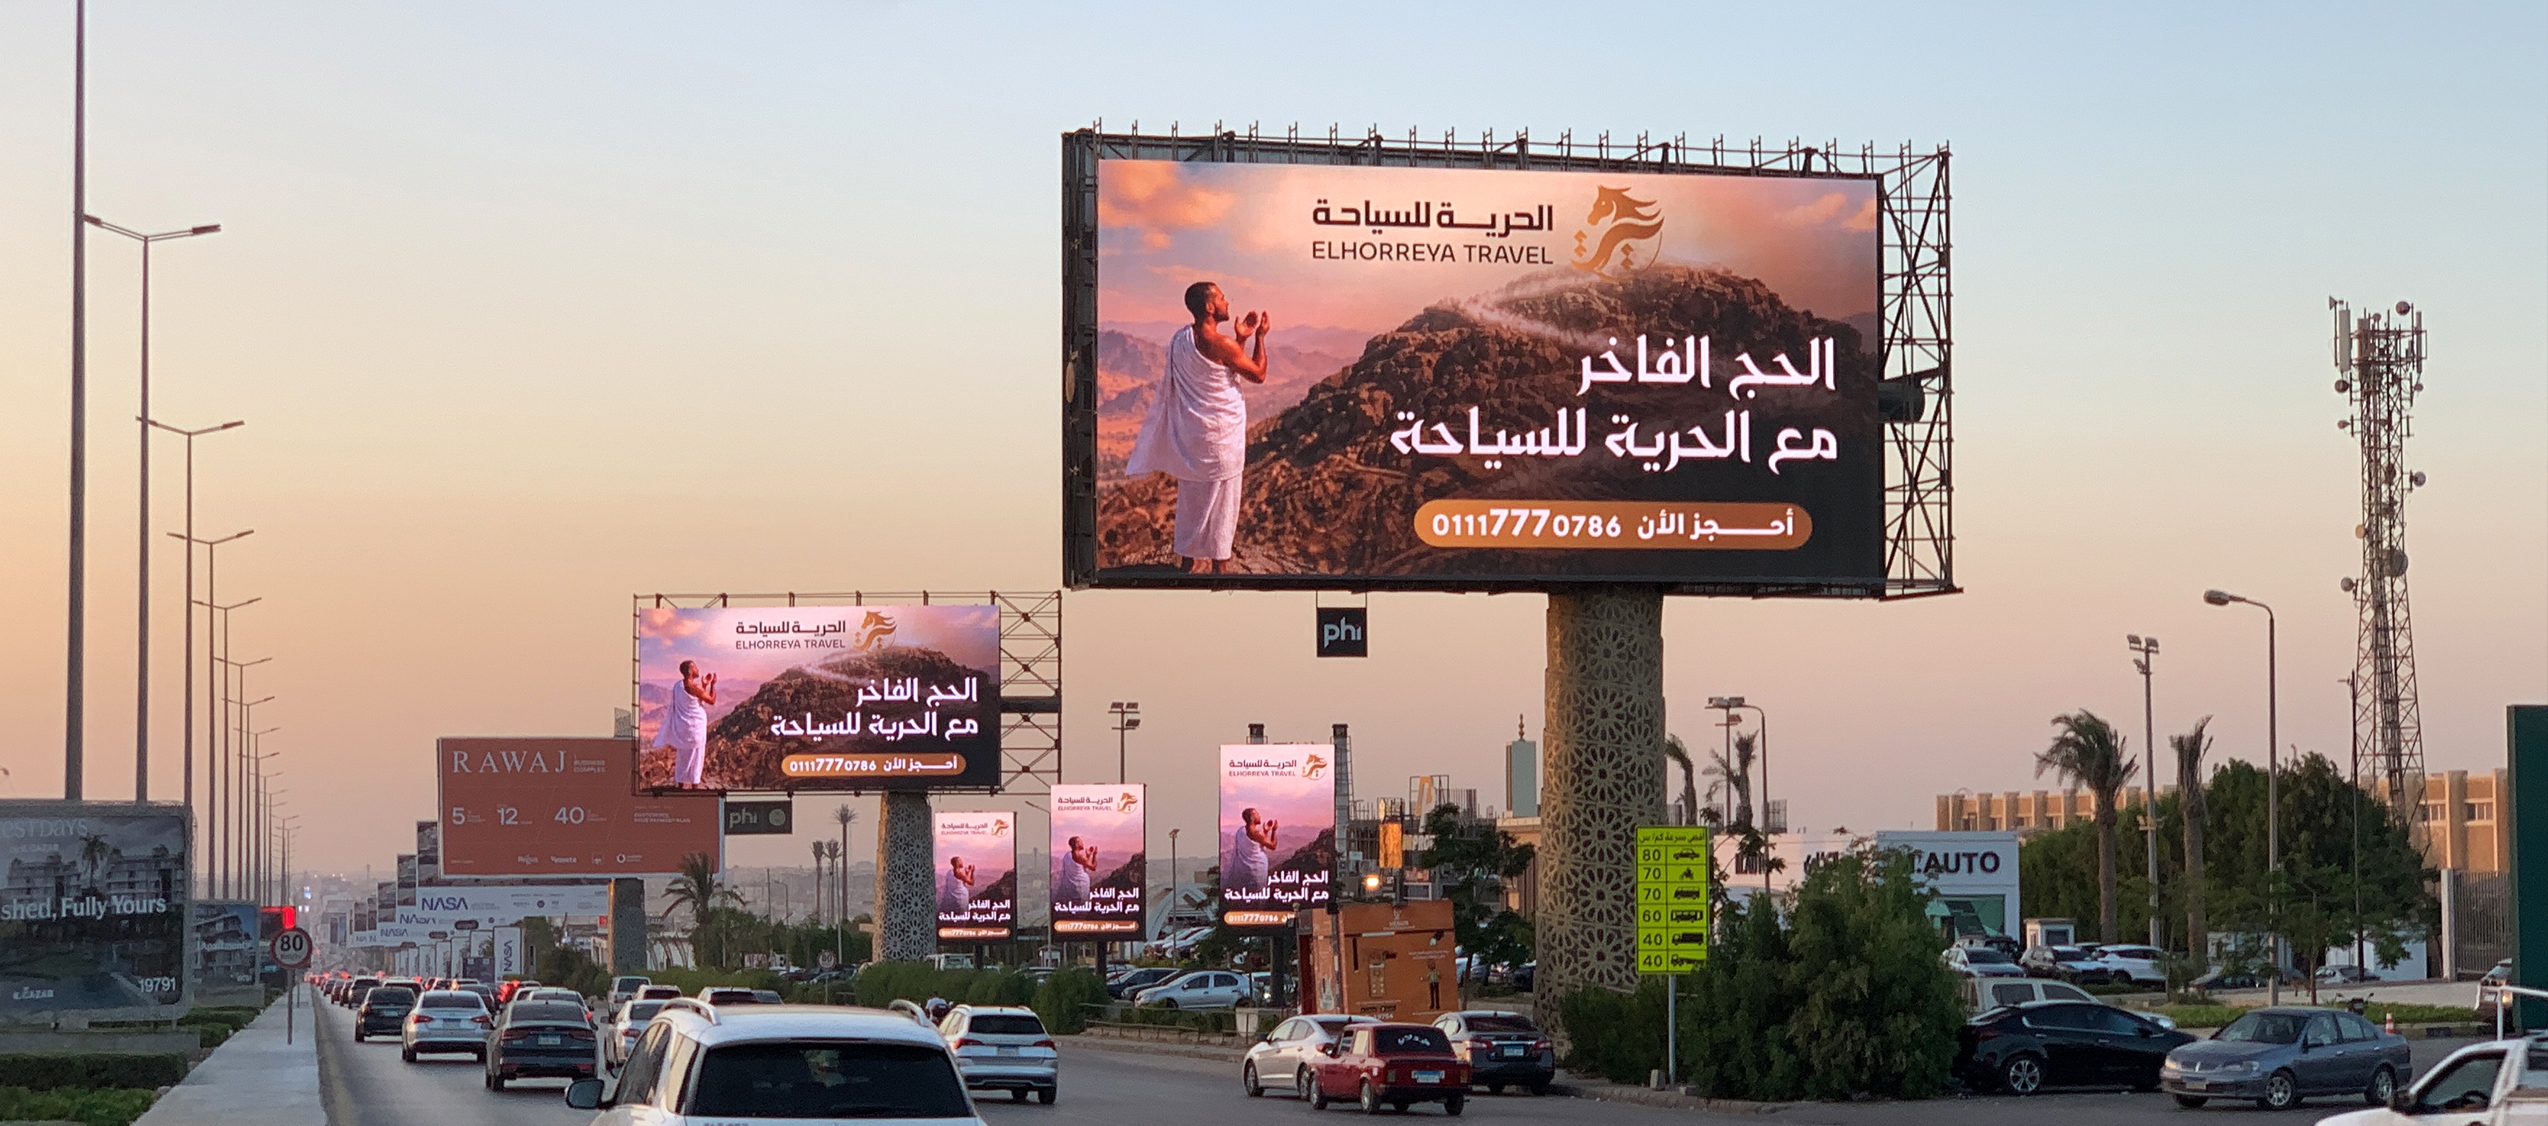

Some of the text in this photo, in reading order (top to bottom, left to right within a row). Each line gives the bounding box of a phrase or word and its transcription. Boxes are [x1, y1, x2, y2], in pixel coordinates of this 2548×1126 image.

[1312, 198, 1554, 238] الحرية للسياحة
[1312, 241, 1554, 265] ELHORREYA TRAVEL
[1576, 333, 1836, 400] الحج الفاخر
[1389, 406, 1838, 475] مع الحرية للسياحة
[1432, 508, 1795, 542] أحجز الأن 01117770786
[736, 620, 846, 637] الحرية للسياحة
[1323, 616, 1362, 649] phi
[736, 639, 846, 650] ELHORREYA TRAVEL
[856, 676, 978, 708] الحج الفاخر
[770, 711, 979, 742] مع الحرية للسياحة
[453, 750, 567, 774] RAWAJ
[789, 757, 877, 772] 01117770786
[452, 807, 466, 825] 5
[497, 807, 518, 825] 12
[554, 806, 585, 825] 40
[1642, 848, 1662, 861] 80
[1267, 870, 1329, 886] الحج الفاخر
[1643, 867, 1662, 880] 70
[1089, 887, 1139, 900] الحج الفاخر
[1224, 887, 1329, 903] مع الحرية للسياحة
[1643, 888, 1662, 900] 70
[61, 897, 108, 919] Fully
[110, 895, 167, 915] Yours
[421, 897, 469, 911] NASA
[1054, 901, 1140, 914] مع الحرية للسياحة
[1642, 910, 1662, 922] 60
[280, 934, 304, 952] 80
[1642, 934, 1663, 946] 40
[1642, 955, 1663, 967] 40
[138, 976, 177, 993] 19791
